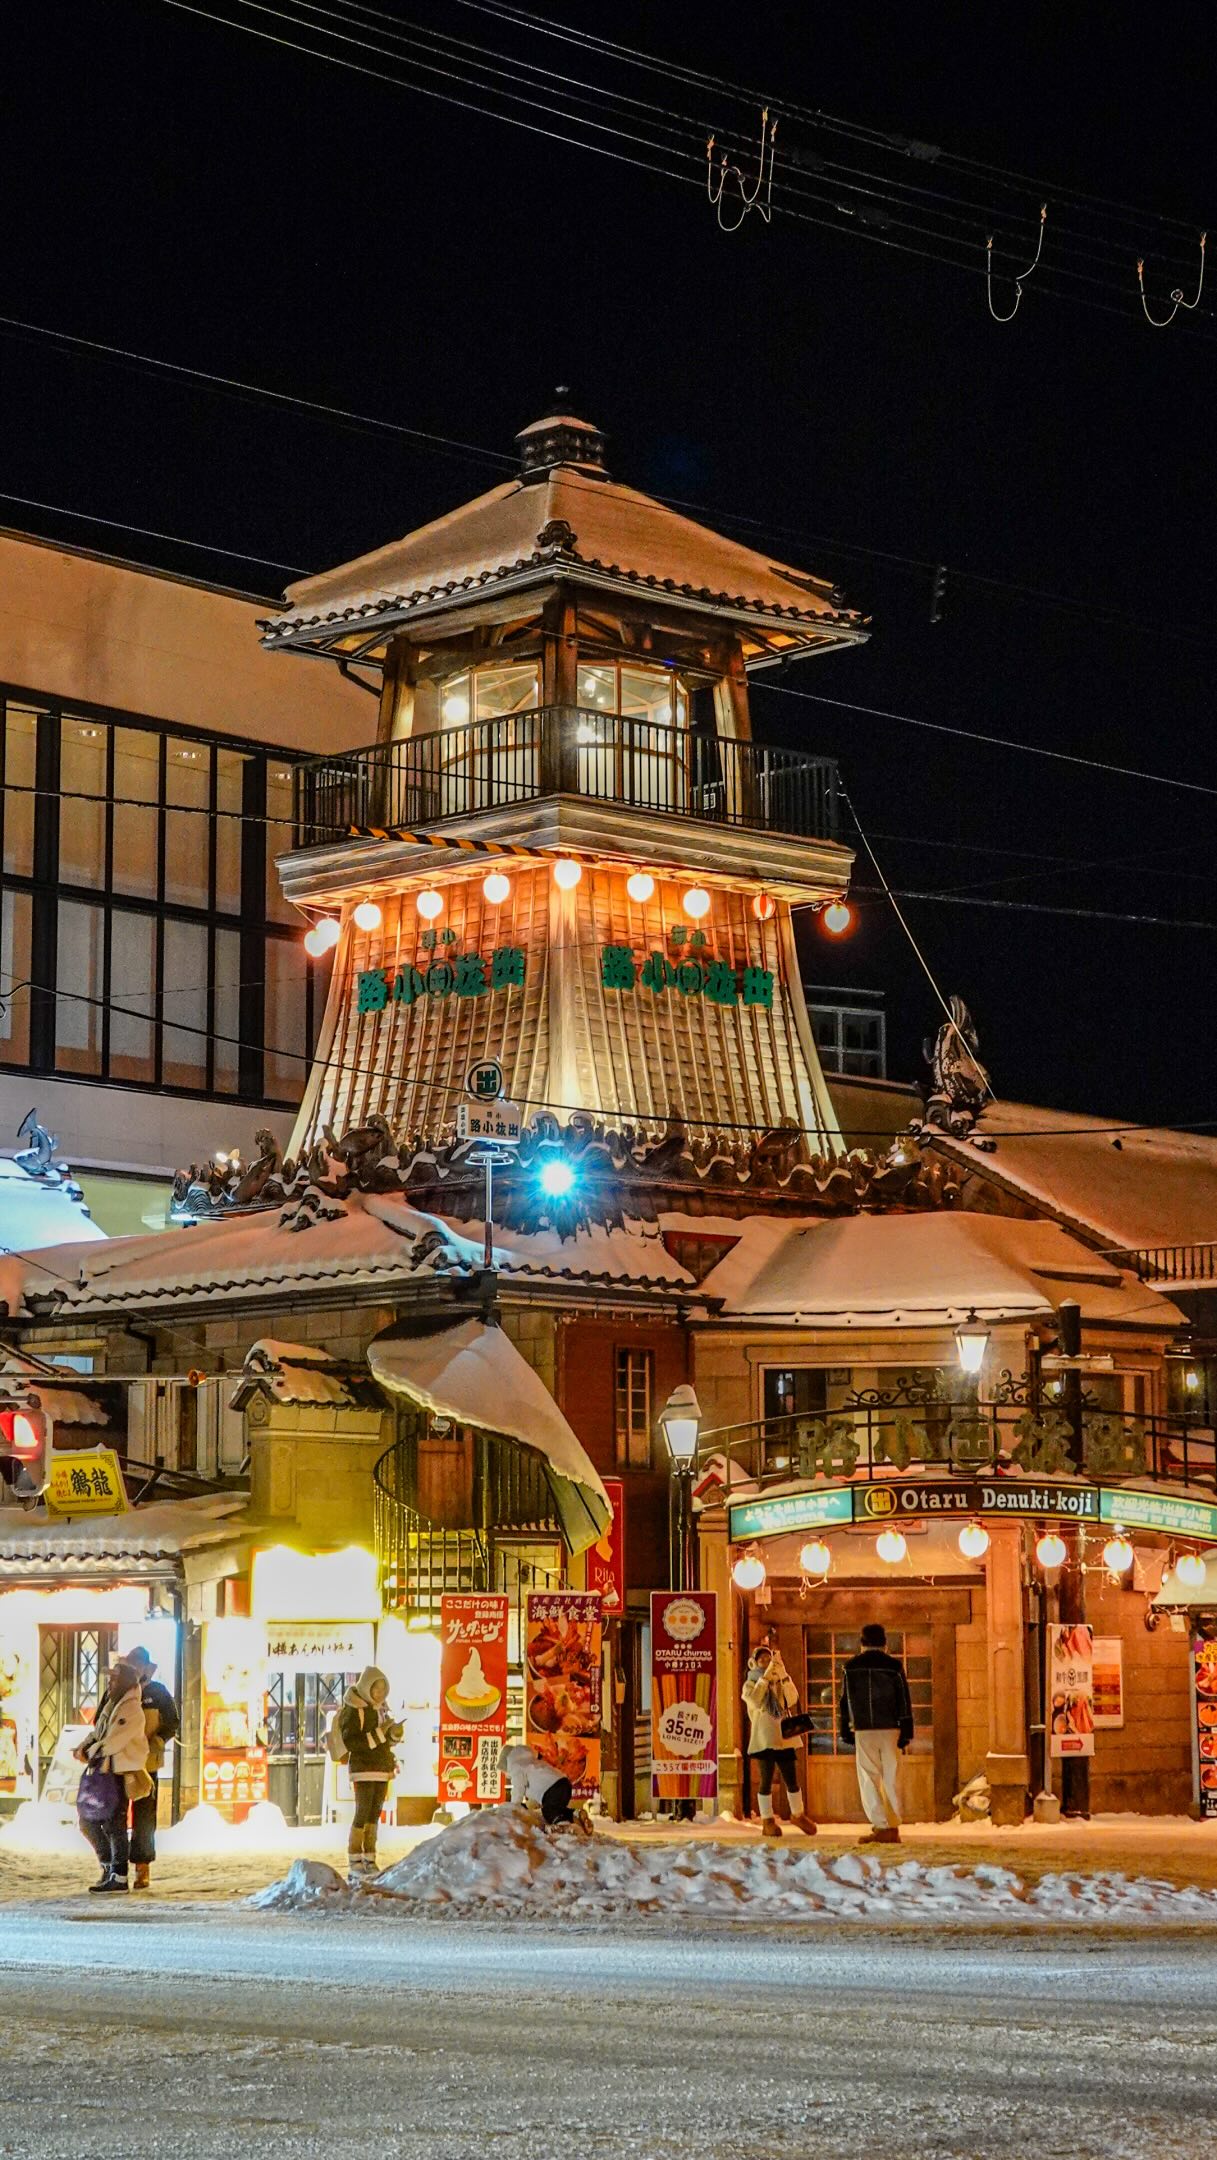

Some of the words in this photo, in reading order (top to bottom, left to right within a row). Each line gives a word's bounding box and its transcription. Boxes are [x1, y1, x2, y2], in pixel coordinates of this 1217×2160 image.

[901, 1489, 969, 1510] Otaru
[981, 1488, 1092, 1516] Denuki-koji
[532, 1605, 599, 1620] 海鮮食堂
[665, 1719, 704, 1739] 35cm
